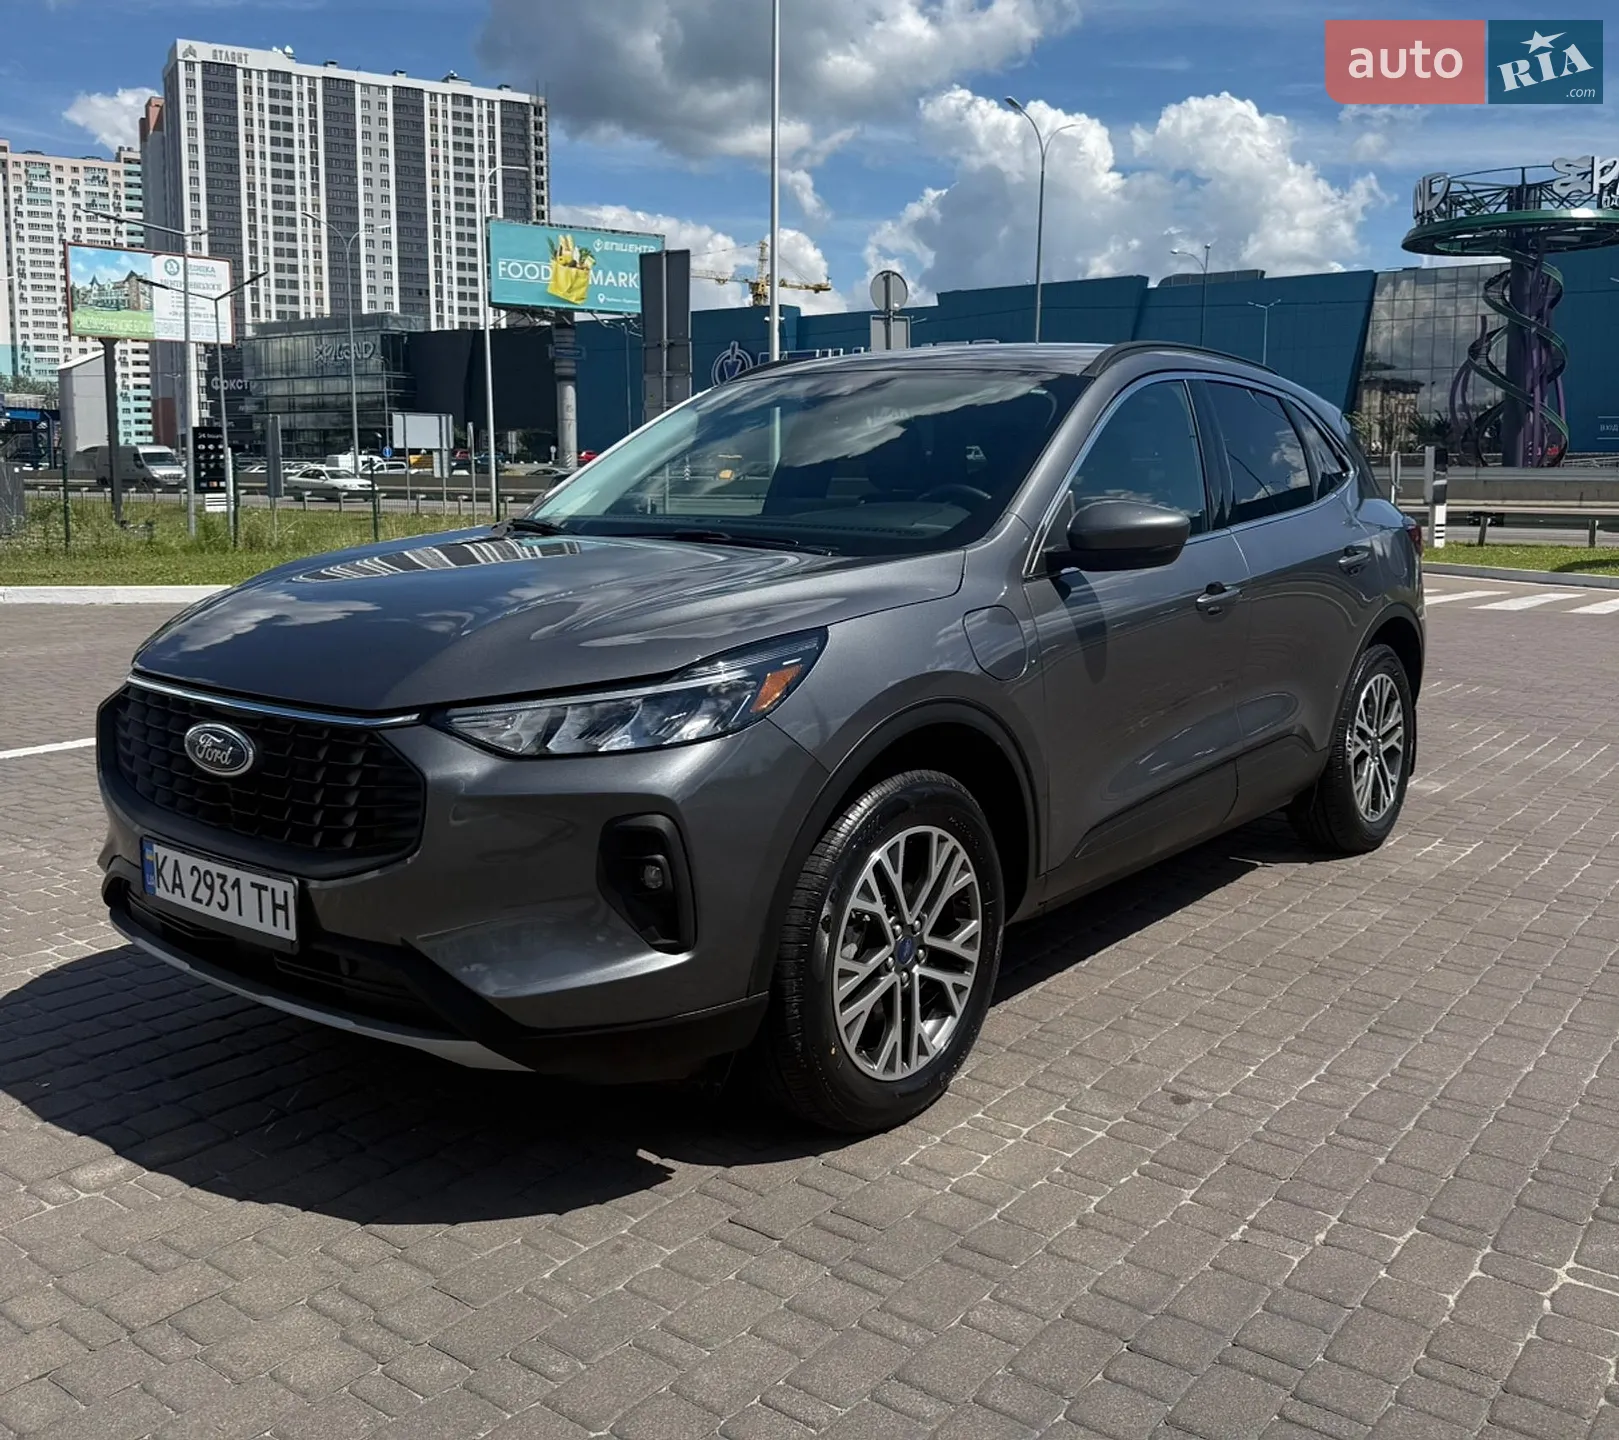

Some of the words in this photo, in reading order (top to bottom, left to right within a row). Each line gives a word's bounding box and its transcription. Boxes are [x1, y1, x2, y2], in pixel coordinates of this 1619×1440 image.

[498, 261, 553, 281] FOOD
[588, 269, 640, 289] MARK
[196, 733, 233, 765] Ford
[190, 865, 243, 917] 2931
[250, 881, 290, 931] TH
